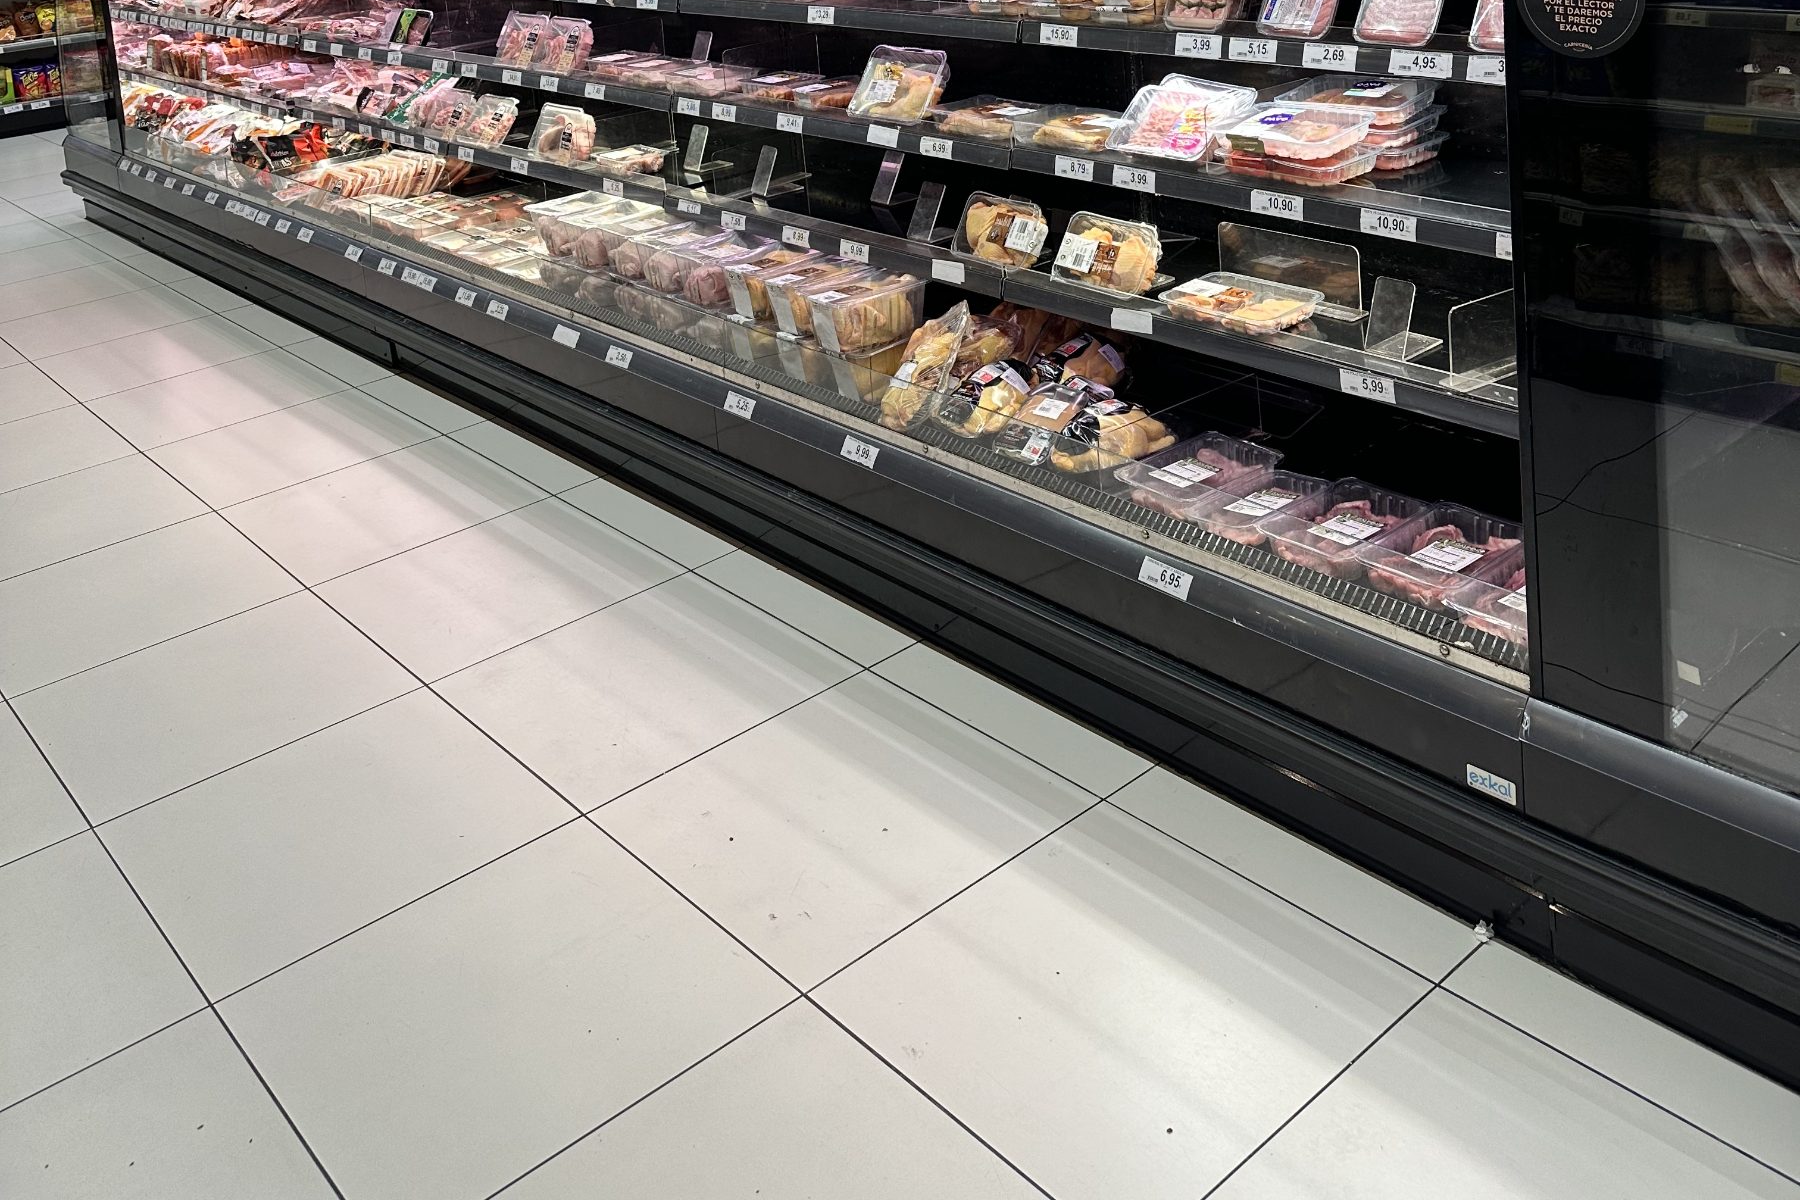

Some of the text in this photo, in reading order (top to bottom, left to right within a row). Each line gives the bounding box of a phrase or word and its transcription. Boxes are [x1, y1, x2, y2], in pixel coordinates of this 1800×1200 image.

[1544, 5, 1613, 18] Y TE DAREMOS
[1578, 0, 1615, 10] LECTOR
[1555, 14, 1603, 26] EL PRECIO
[1050, 29, 1070, 41] 15,90
[1559, 24, 1598, 34] EXACTO
[1192, 39, 1211, 52] 3,99
[1247, 42, 1267, 56] 5,15
[1323, 49, 1345, 64] 2,69
[1412, 56, 1436, 71] 4,95
[1070, 162, 1086, 175] 8,79
[1130, 172, 1147, 185] 3,99
[1267, 197, 1293, 215] 10,90
[1376, 215, 1405, 233] 10,90
[1362, 377, 1384, 395] 5,99
[856, 444, 870, 460] 9,99
[1160, 569, 1182, 588] 6,95
[1469, 771, 1512, 799] exkal
